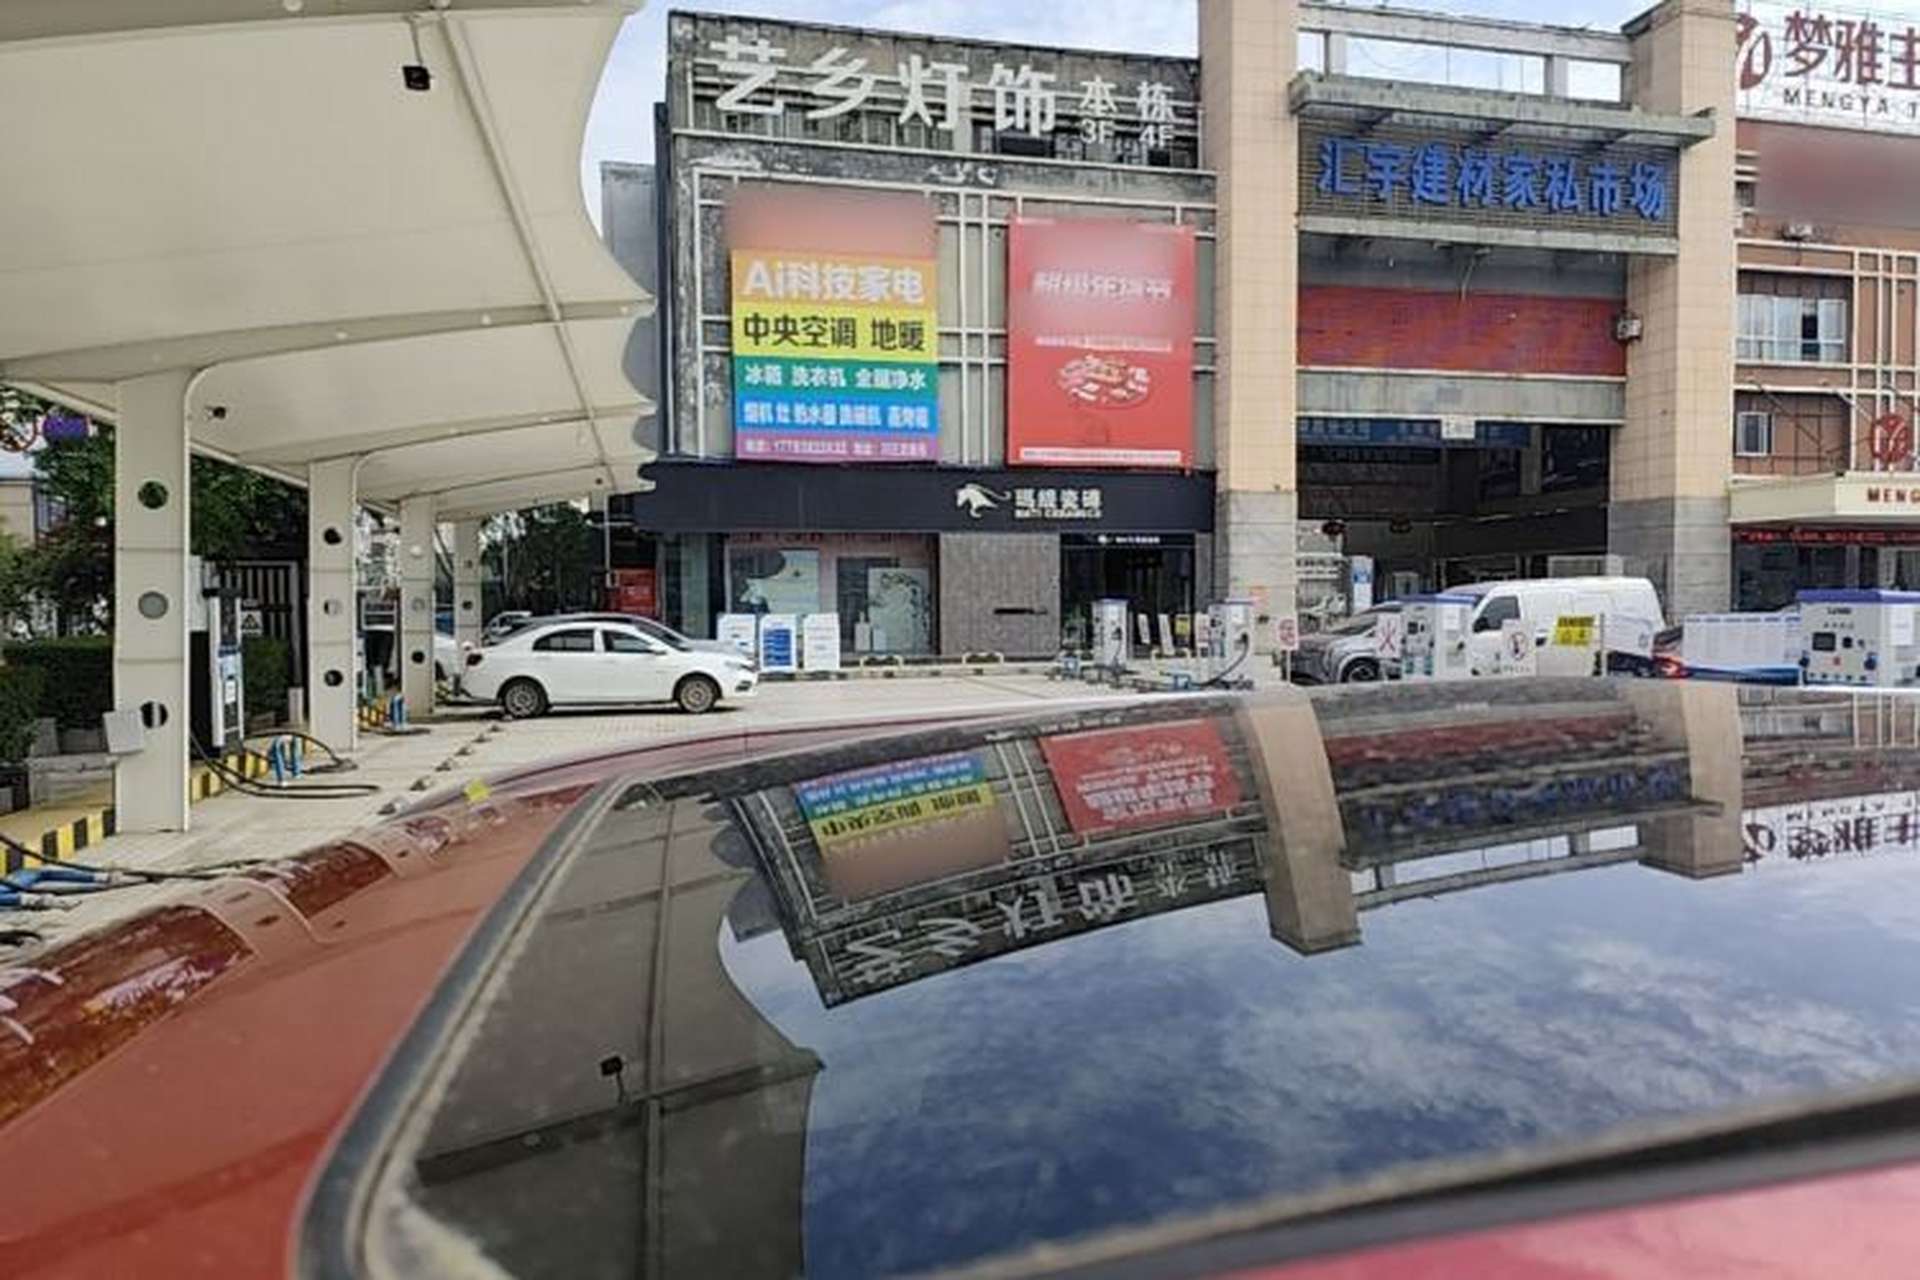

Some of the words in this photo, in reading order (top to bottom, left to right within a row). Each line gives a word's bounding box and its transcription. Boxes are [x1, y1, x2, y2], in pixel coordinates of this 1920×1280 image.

[709, 36, 1057, 138] 艺乡灯饰
[1783, 88, 1889, 114] MENGYA
[1080, 119, 1114, 145] 3F
[1139, 121, 1174, 147] 4F
[1319, 139, 1669, 220] 汇宇建材家私市场
[743, 260, 924, 304] Ai科技家电
[743, 313, 857, 350] 中央空调
[870, 317, 926, 351] 地暖
